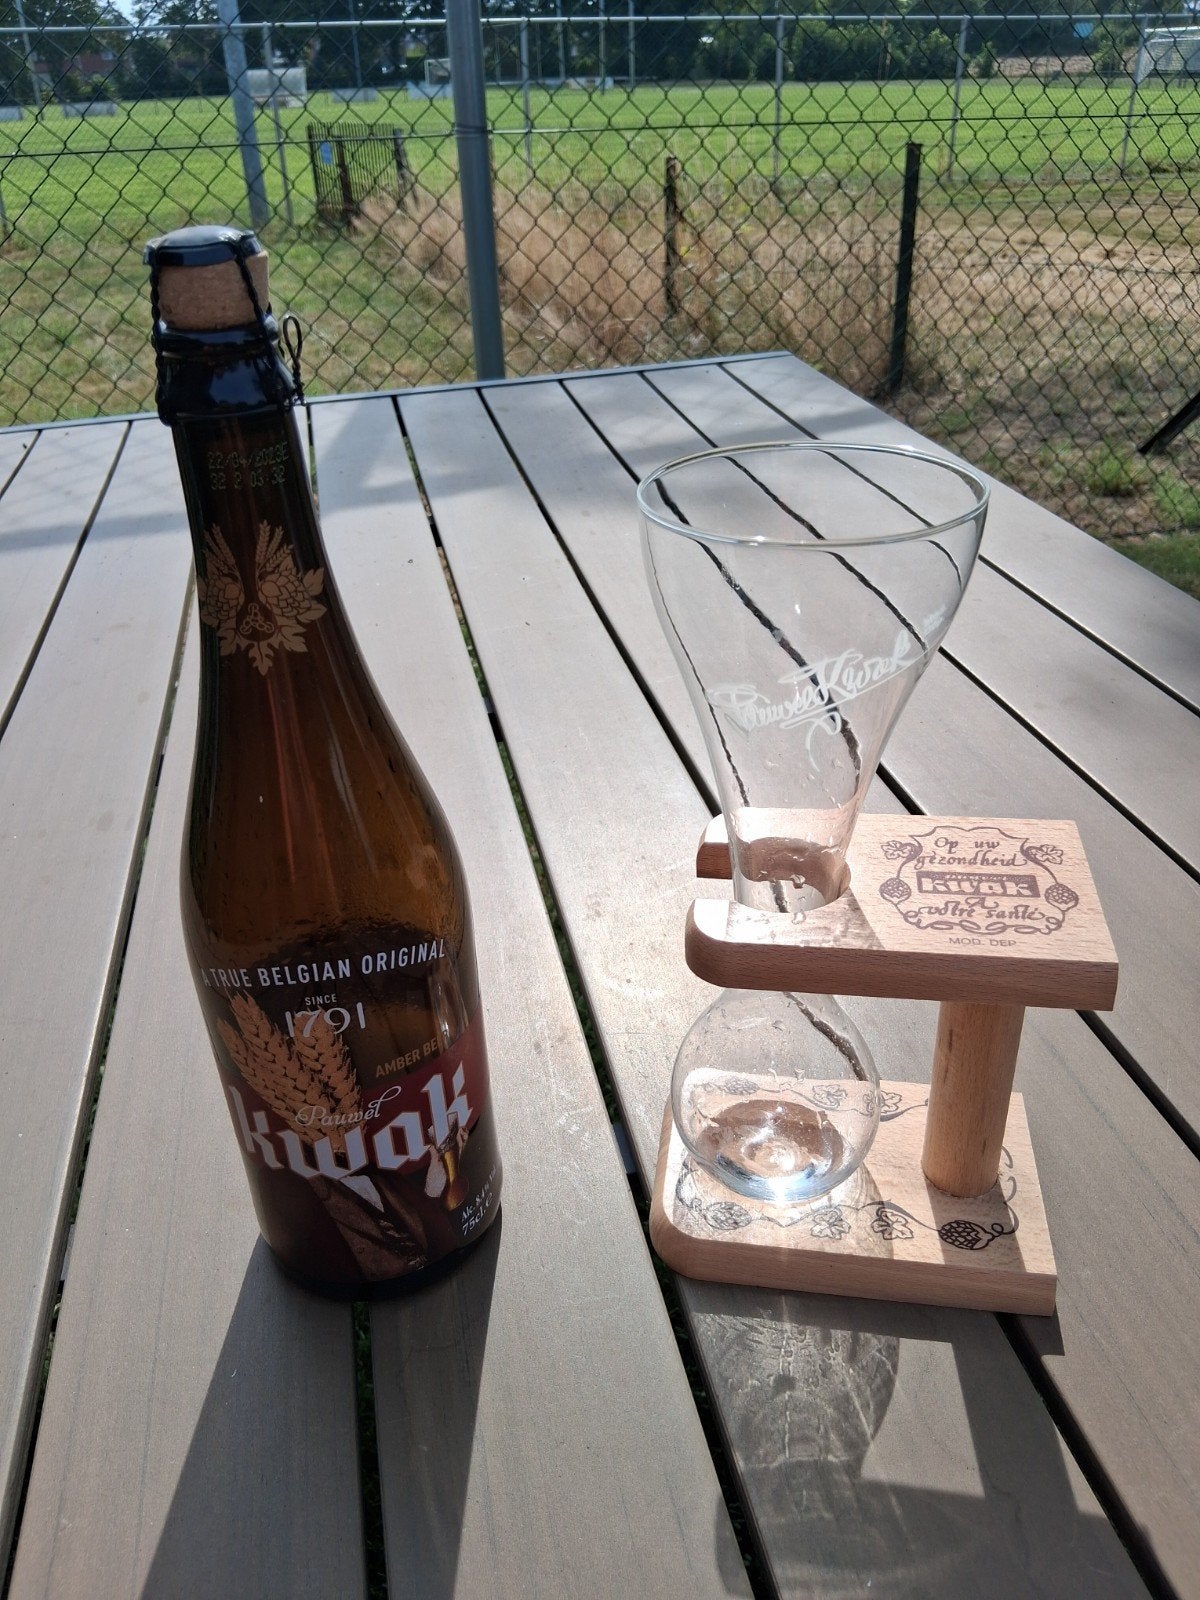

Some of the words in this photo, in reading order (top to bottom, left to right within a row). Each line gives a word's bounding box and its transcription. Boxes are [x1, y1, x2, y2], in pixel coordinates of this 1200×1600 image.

[914, 850, 1028, 871] gezondheid
[934, 836, 959, 854] Op
[974, 840, 1000, 849] uw
[201, 968, 213, 987] A
[210, 968, 253, 988] TRUE
[257, 958, 351, 988] BELGIAN
[361, 938, 446, 975] ORIGINAL
[304, 993, 337, 1006] SINCE
[284, 1002, 366, 1038] 1791
[376, 1048, 421, 1078] AMBER
[228, 1060, 474, 1181] kwak
[295, 1085, 402, 1126] Pauwel
